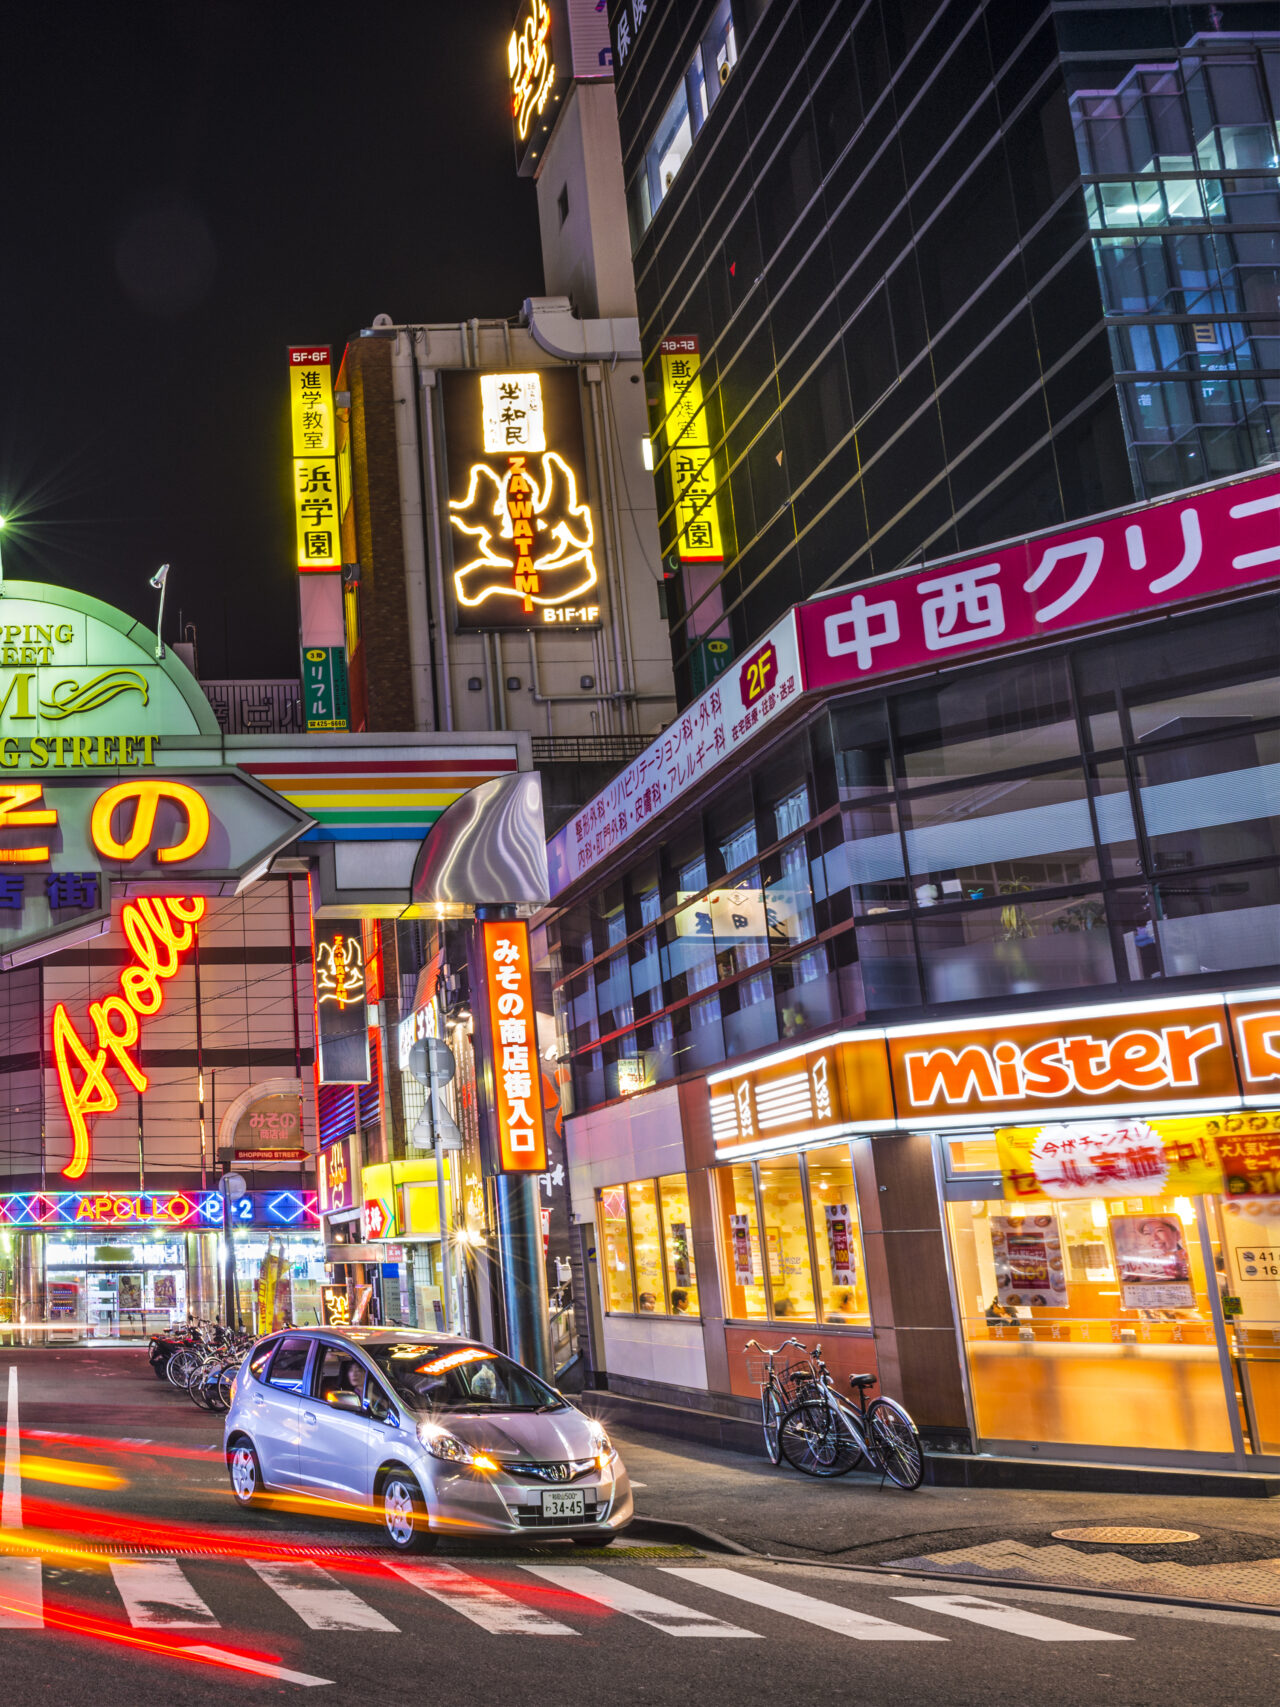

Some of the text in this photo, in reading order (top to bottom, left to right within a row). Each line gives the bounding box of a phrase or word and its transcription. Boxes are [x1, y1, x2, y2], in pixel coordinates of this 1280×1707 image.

[300, 371, 324, 449] 進学教室
[299, 465, 333, 558] 浜学園
[814, 492, 1280, 671] 中西クリニ
[747, 649, 772, 700] 2F
[30, 734, 160, 767] STREET
[575, 688, 722, 843] 整形外科・リハビリテーション科・外科
[493, 939, 535, 1152] みその商店街入口
[249, 1112, 297, 1128] みその
[260, 1129, 288, 1139] 商店街
[239, 1150, 273, 1158] SHOPPING
[76, 1197, 189, 1220] APOLLO
[552, 1501, 583, 1515] 34-45
